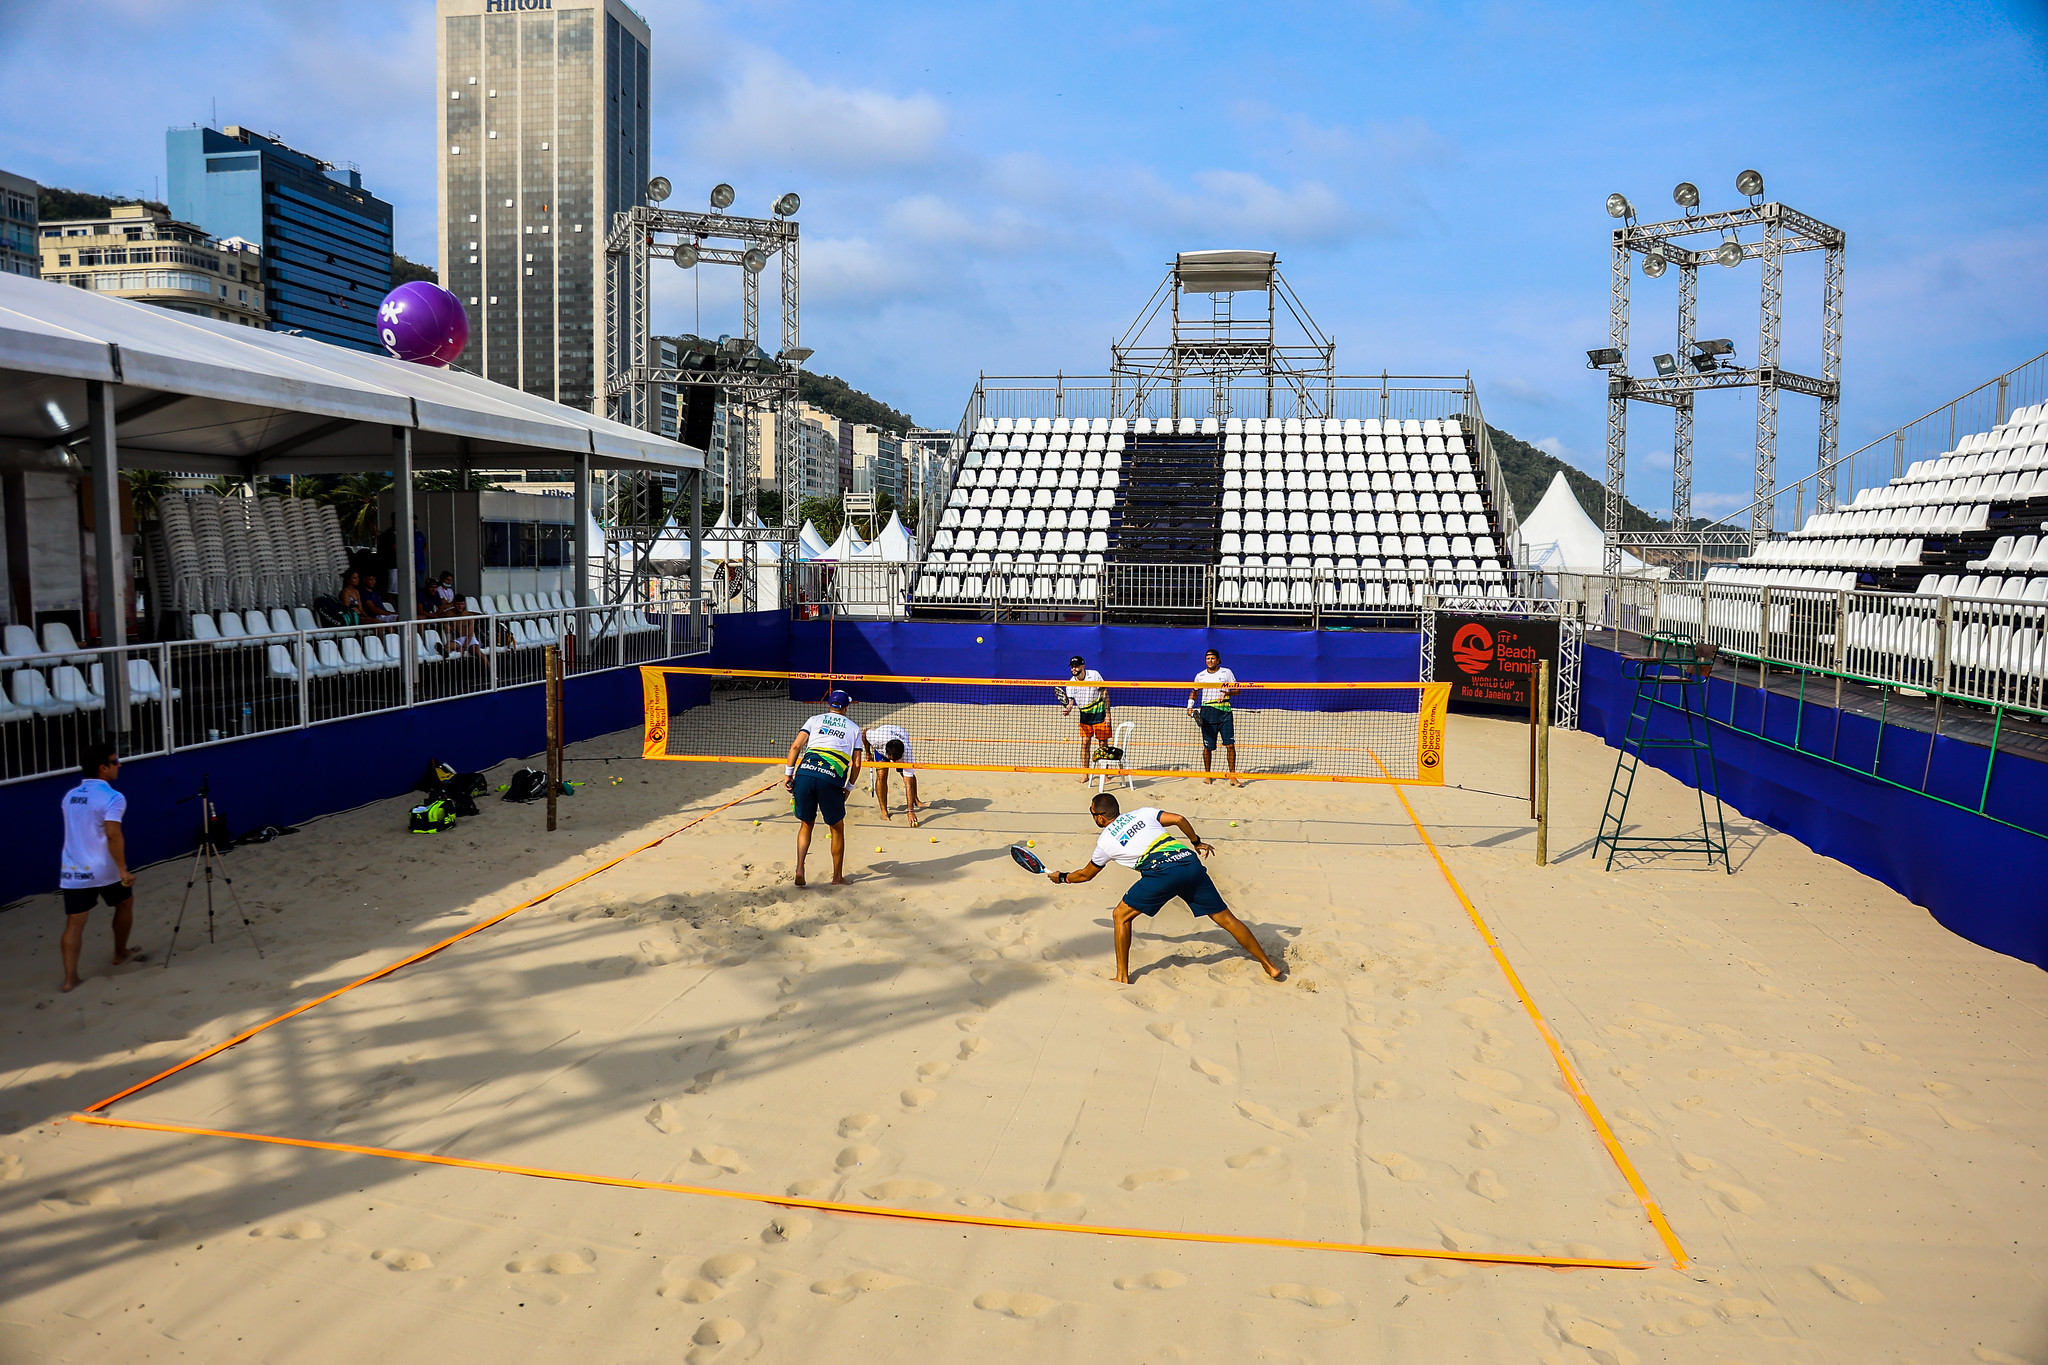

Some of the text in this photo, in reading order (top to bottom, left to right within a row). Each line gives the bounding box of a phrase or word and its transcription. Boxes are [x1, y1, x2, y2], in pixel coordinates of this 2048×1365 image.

[486, 0, 552, 12] Hilton
[542, 488, 575, 500] Hilto
[1497, 634, 1511, 643] ITF
[1497, 644, 1536, 659] Beach
[1471, 676, 1515, 690] WORLD CUP
[1461, 686, 1524, 702] Rio de Janeiro '21
[823, 719, 847, 728] BRASIL
[828, 728, 845, 739] BRB
[1110, 815, 1137, 837] BRASIL
[1126, 820, 1146, 838] BRB
